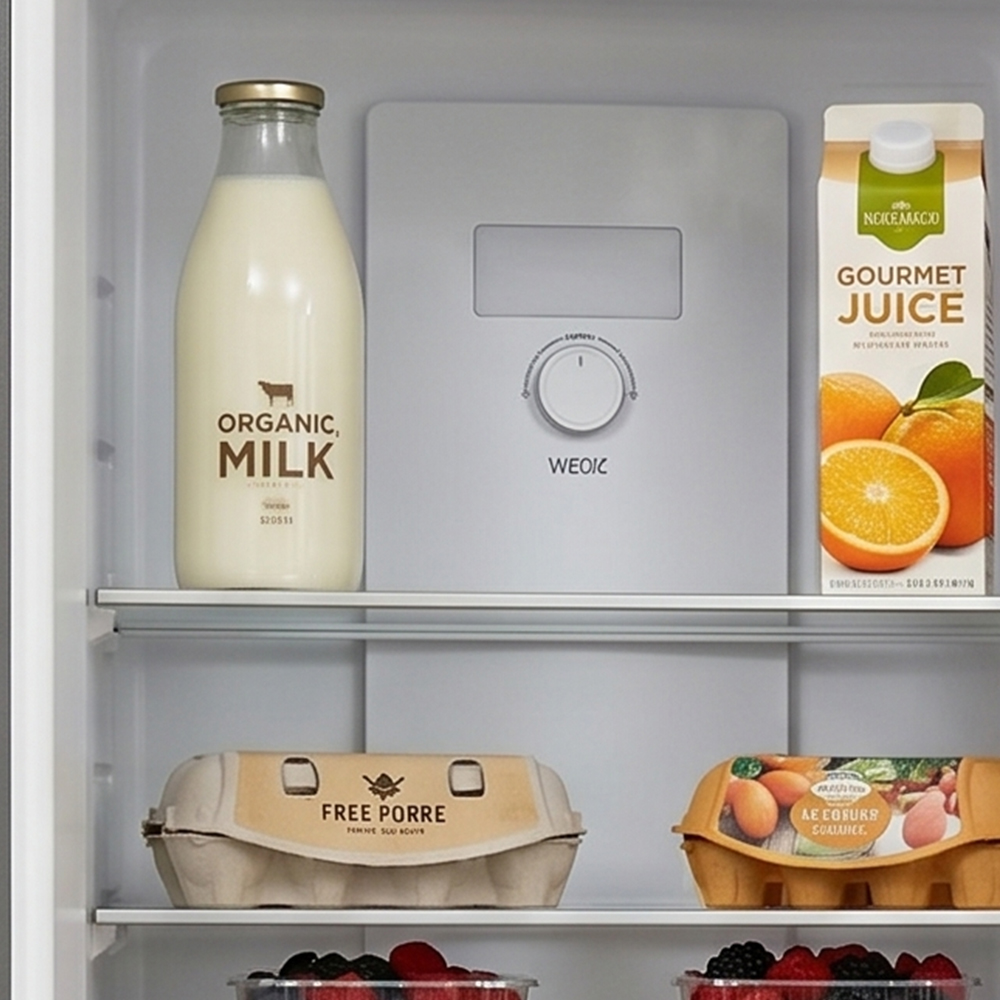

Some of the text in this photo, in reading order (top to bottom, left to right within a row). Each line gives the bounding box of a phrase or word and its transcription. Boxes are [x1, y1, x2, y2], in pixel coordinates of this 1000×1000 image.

[837, 266, 966, 286] GOURMET
[838, 292, 964, 324] JUICE
[219, 440, 334, 480] MILK
[322, 804, 446, 823] FREE PORRE
